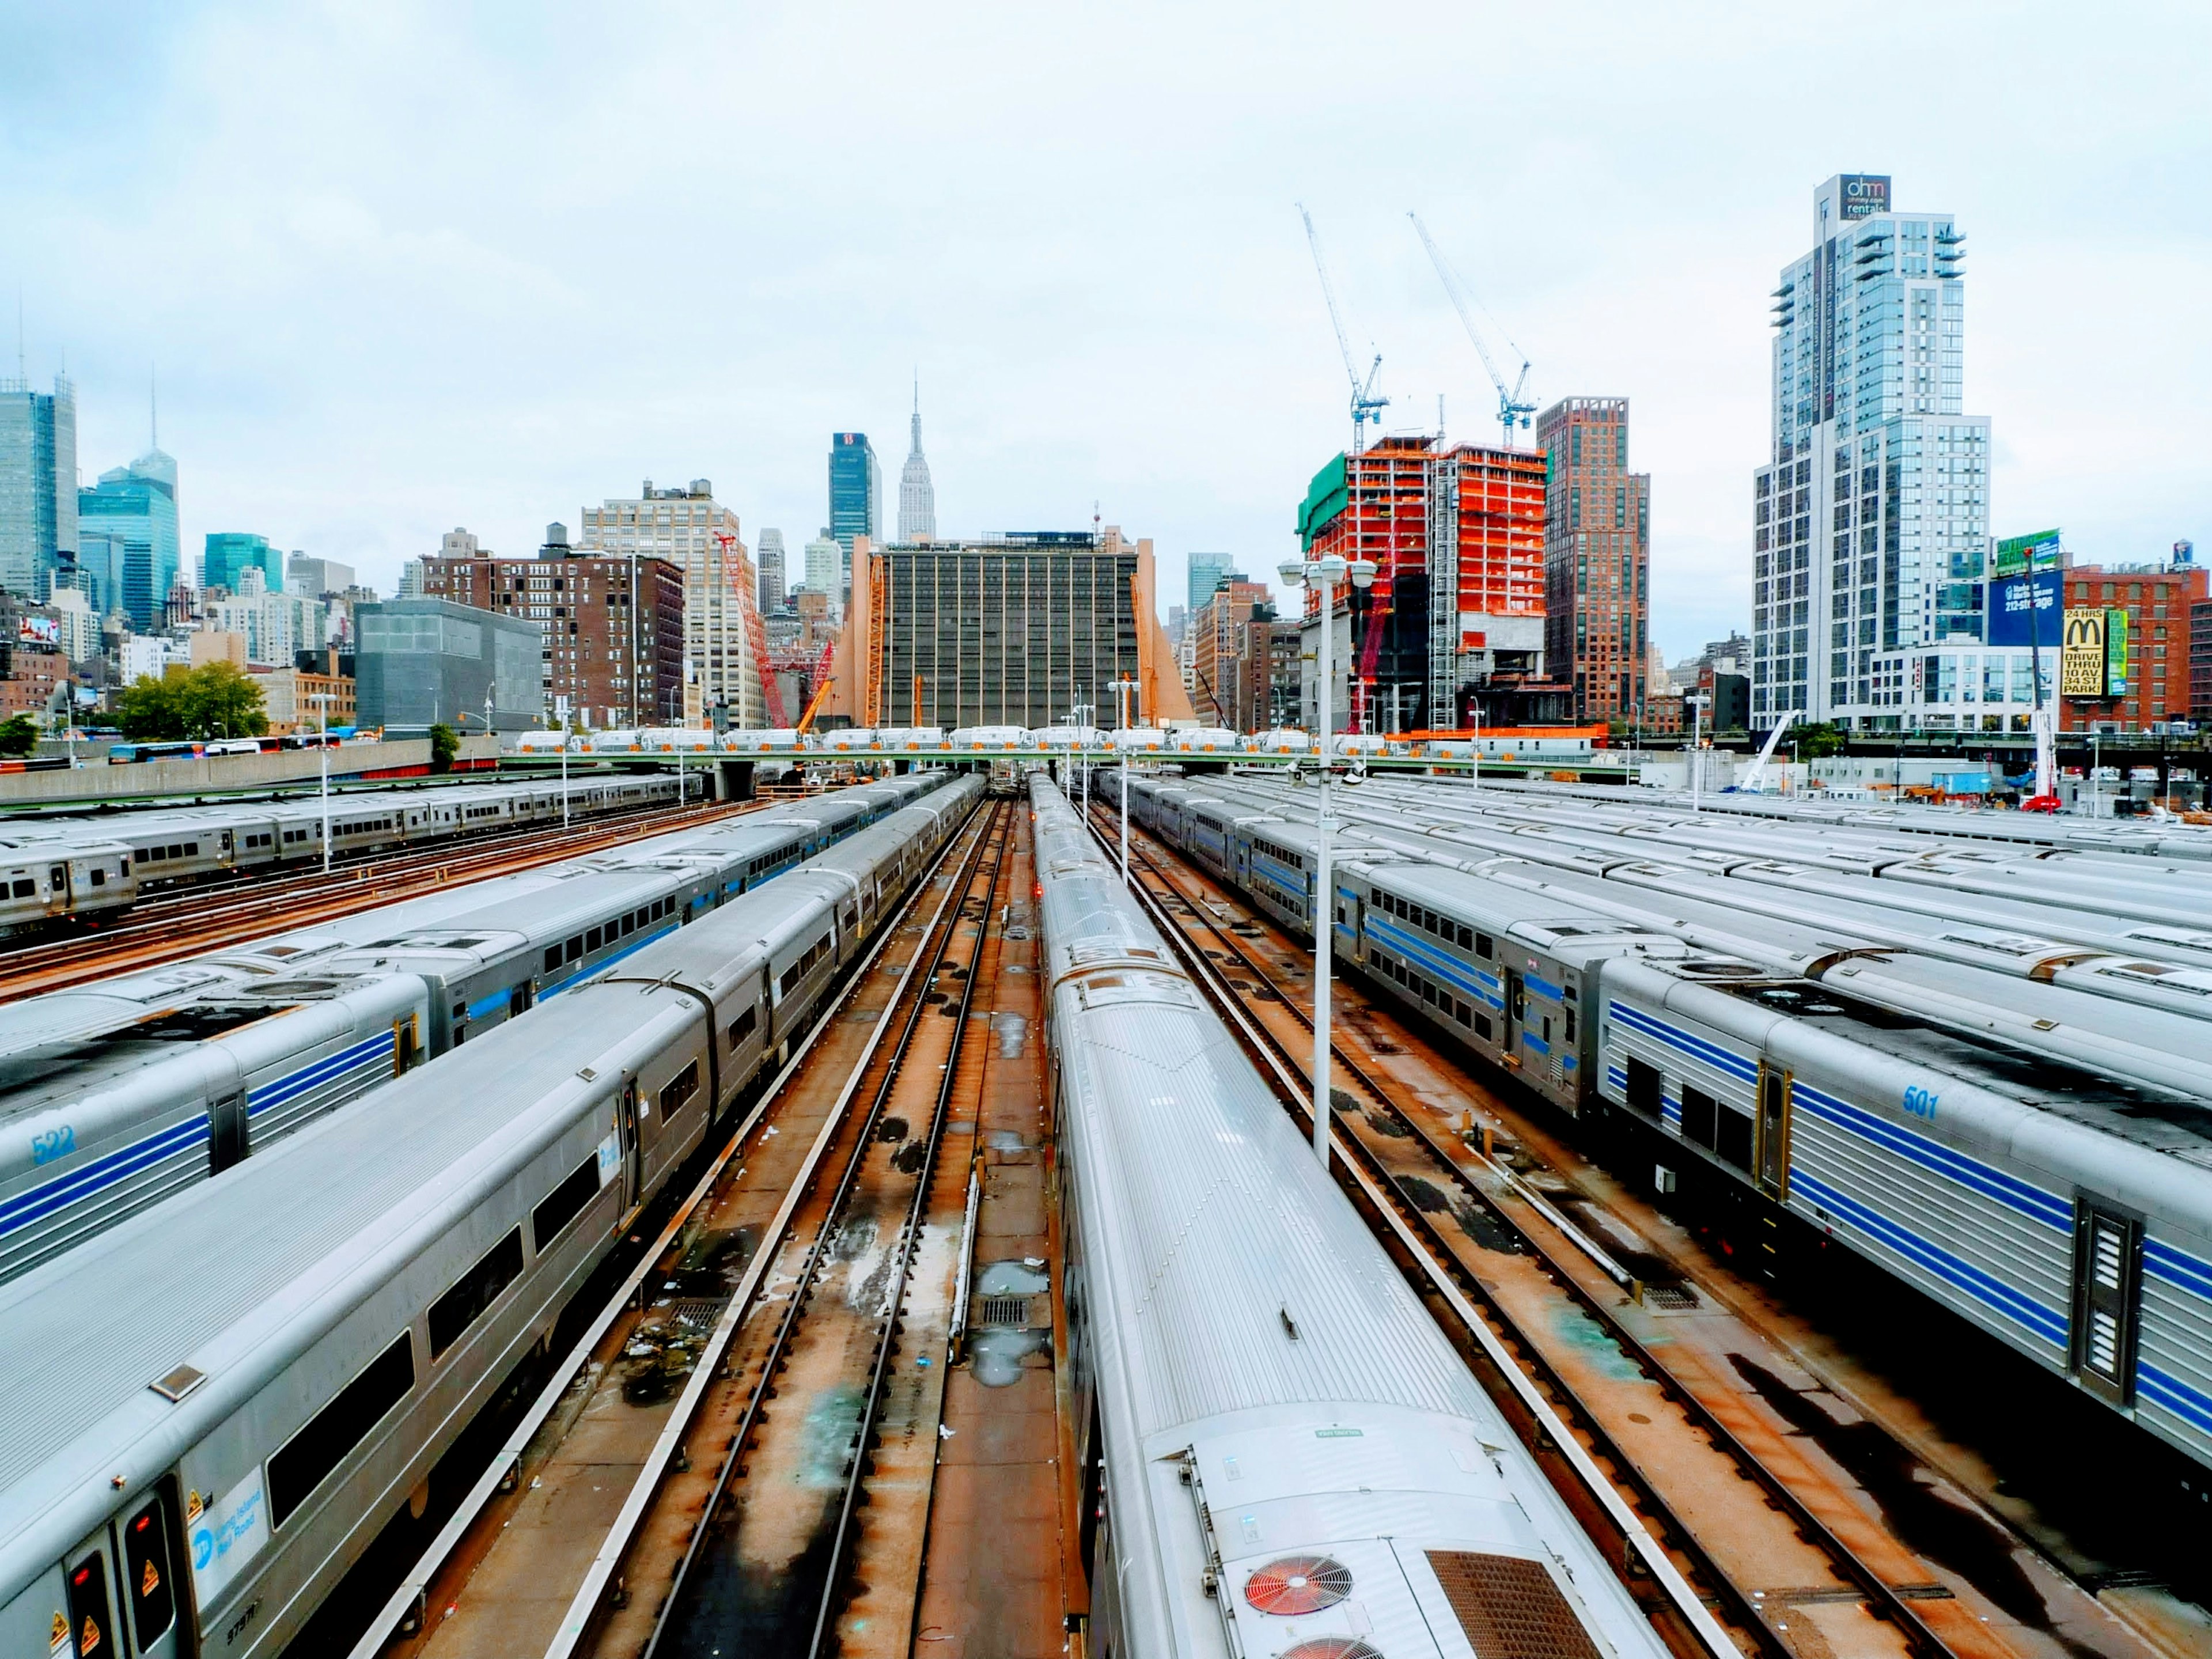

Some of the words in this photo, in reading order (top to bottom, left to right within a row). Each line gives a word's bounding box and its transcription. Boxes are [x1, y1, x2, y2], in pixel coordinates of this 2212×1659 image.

[1847, 177, 1884, 196] ohm
[1847, 204, 1884, 213] rentals
[1827, 301, 1832, 315] no
[1903, 1086, 1939, 1119] 501
[32, 1124, 75, 1166] 522
